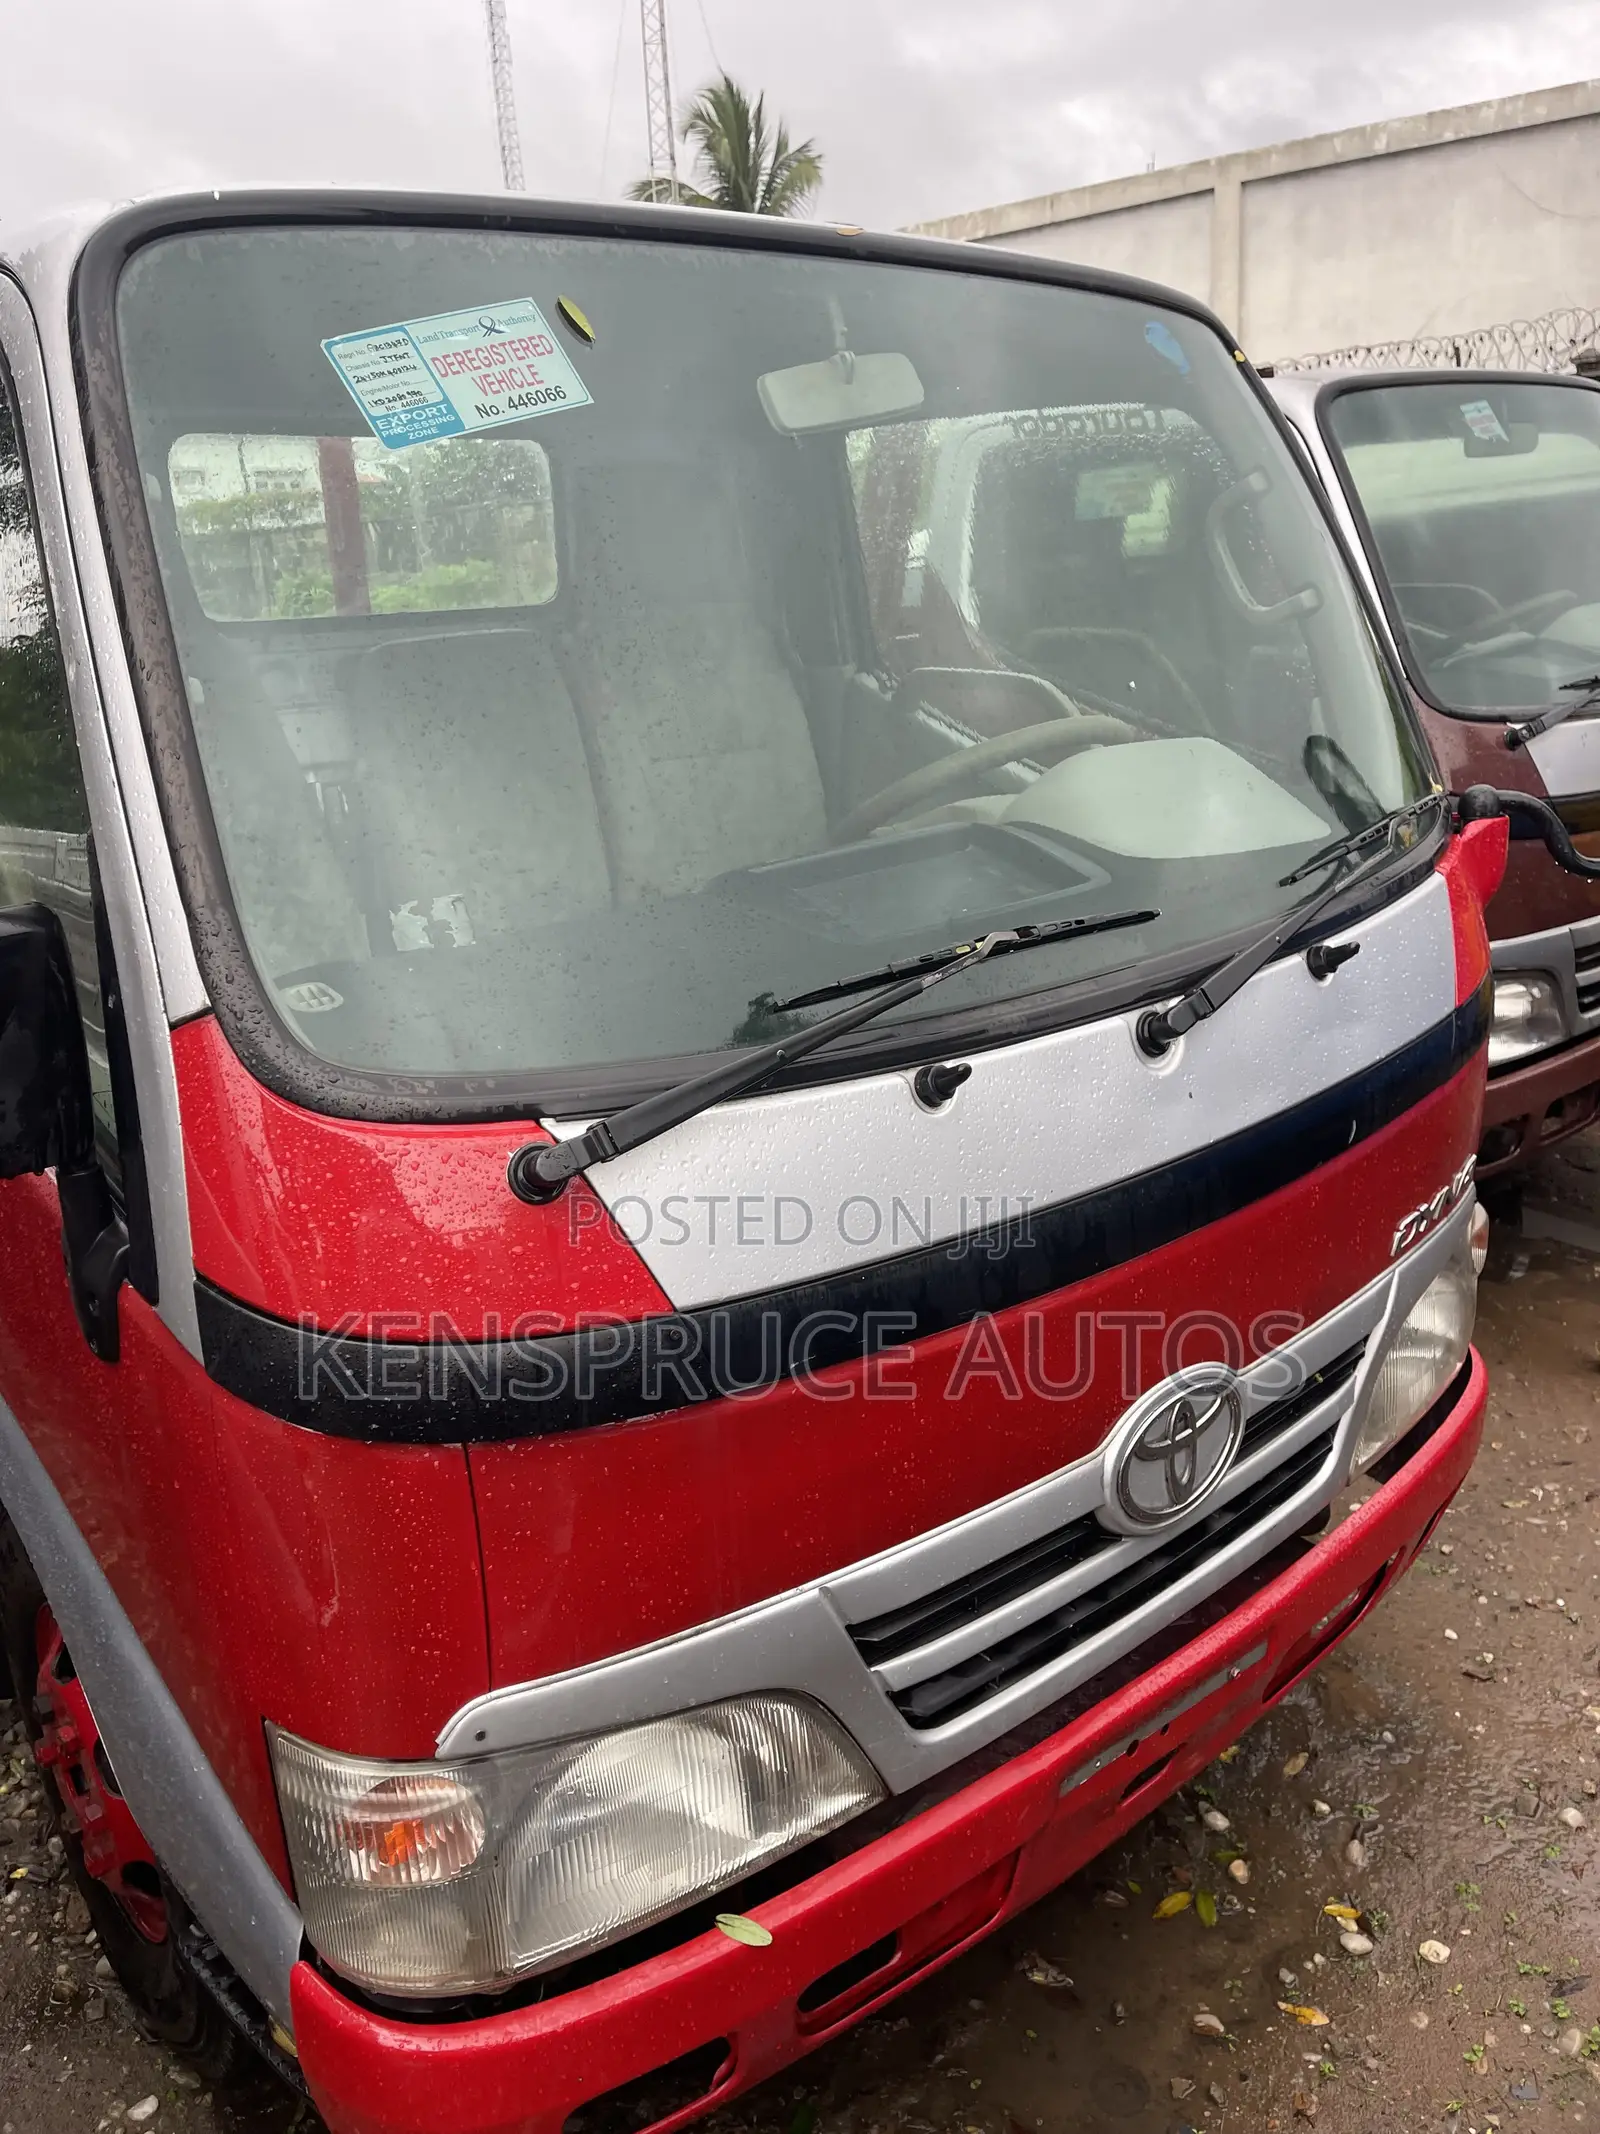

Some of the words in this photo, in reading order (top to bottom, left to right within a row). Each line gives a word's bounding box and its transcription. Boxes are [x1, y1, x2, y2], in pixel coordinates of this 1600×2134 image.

[416, 331, 439, 344] Land
[438, 323, 481, 340] Transport
[497, 313, 536, 328] Authority
[430, 334, 554, 378] DEREGISTERED
[471, 364, 544, 397] VEHICLE
[375, 403, 449, 430] EXPORT
[401, 396, 429, 409] 446066
[474, 404, 505, 419] No.
[508, 385, 567, 411] 446066
[381, 414, 455, 438] PROCESSING
[407, 426, 439, 440] ZONE
